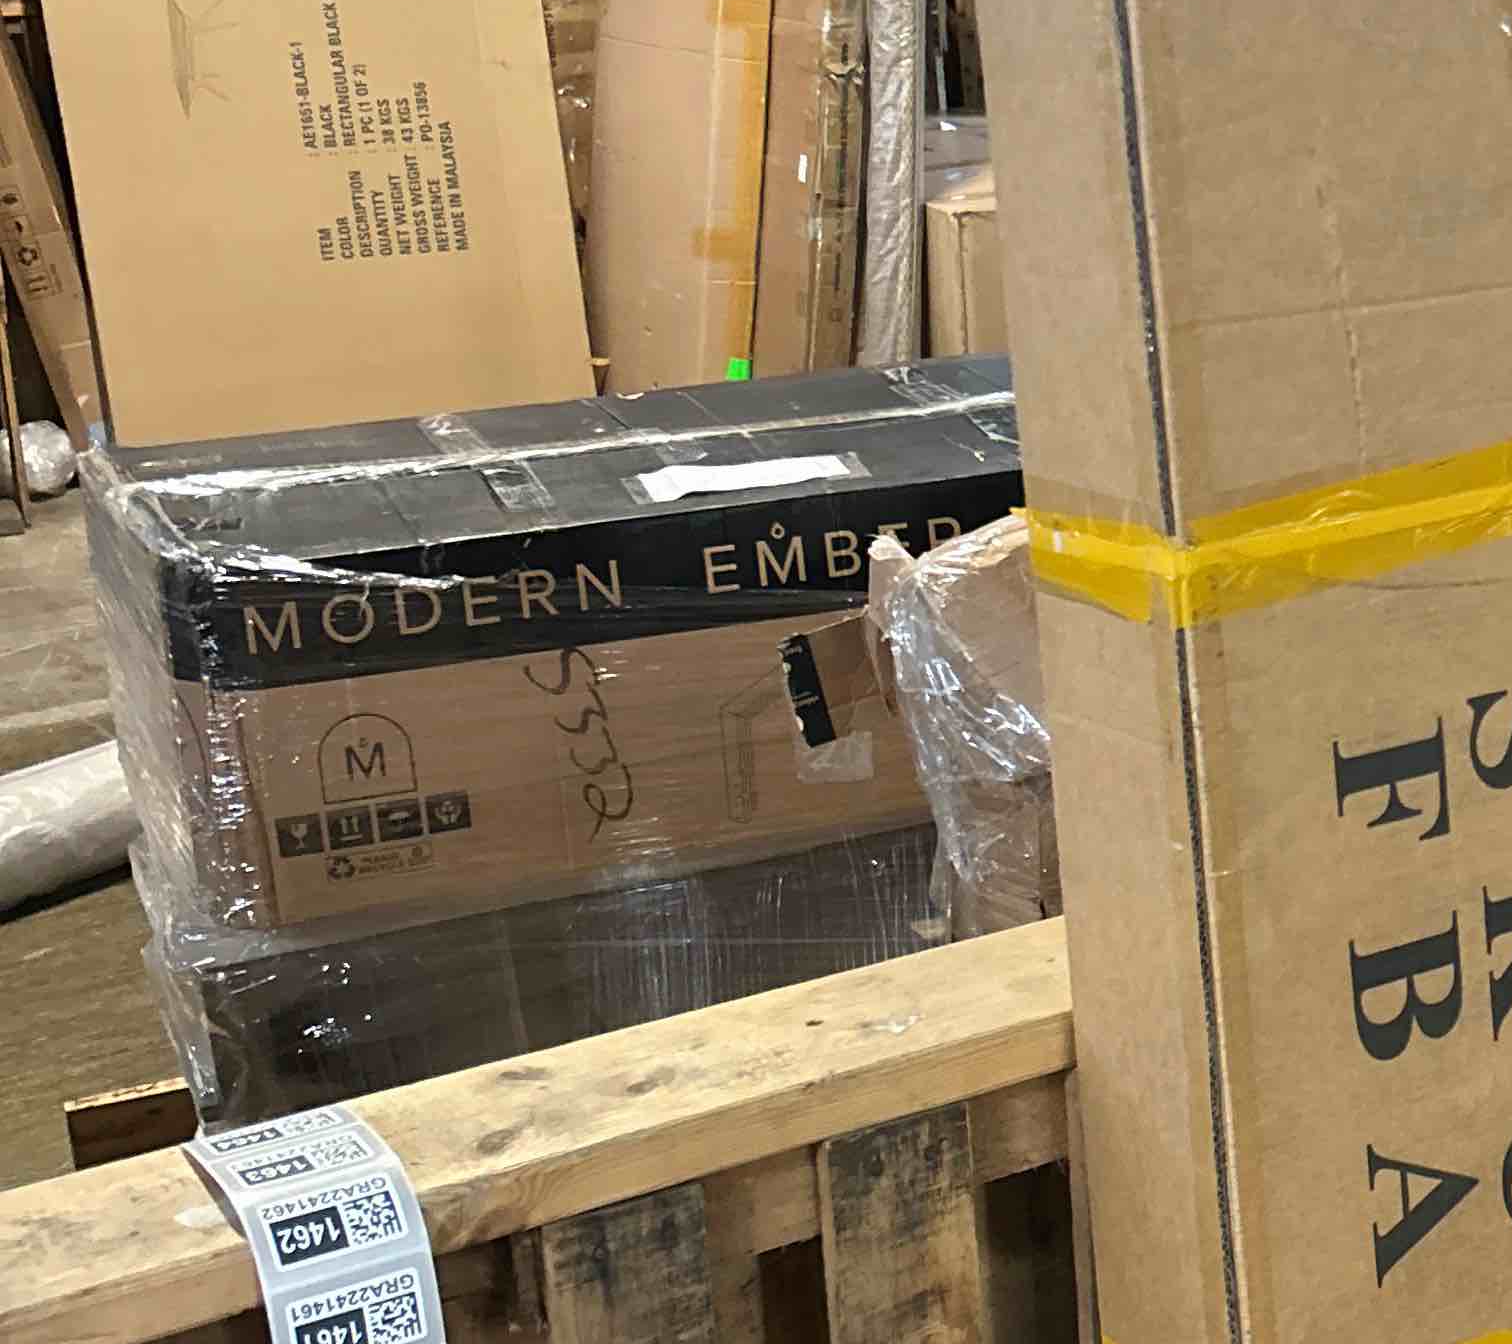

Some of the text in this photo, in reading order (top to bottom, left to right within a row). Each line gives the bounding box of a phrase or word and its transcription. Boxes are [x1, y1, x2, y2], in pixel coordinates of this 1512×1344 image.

[322, 2, 342, 46] BLACK
[330, 49, 356, 146] RECTANGULAR
[354, 78, 369, 96] OF
[359, 115, 374, 133] PC
[376, 98, 392, 125] KGS
[396, 97, 411, 123] KGS
[318, 103, 353, 259] COLOR BLACK
[387, 174, 407, 225] WEIGHT
[403, 154, 423, 206] WEIGHT
[437, 121, 469, 250] MADE IN MALAYSIA
[348, 170, 373, 257] DESCRIPTION
[370, 190, 392, 256] QUANTITY
[413, 209, 431, 253] GROSS
[427, 176, 450, 251] REFERENCE
[317, 227, 335, 260] ITEM
[396, 229, 411, 254] NET
[243, 559, 623, 656] MODERN
[344, 739, 387, 782] M
[1333, 717, 1479, 1288] FBA
[244, 1160, 309, 1182] 1463
[261, 1176, 387, 1221] GRA2241462
[278, 1216, 341, 1254] 1462
[291, 1273, 414, 1323] GRA2241461
